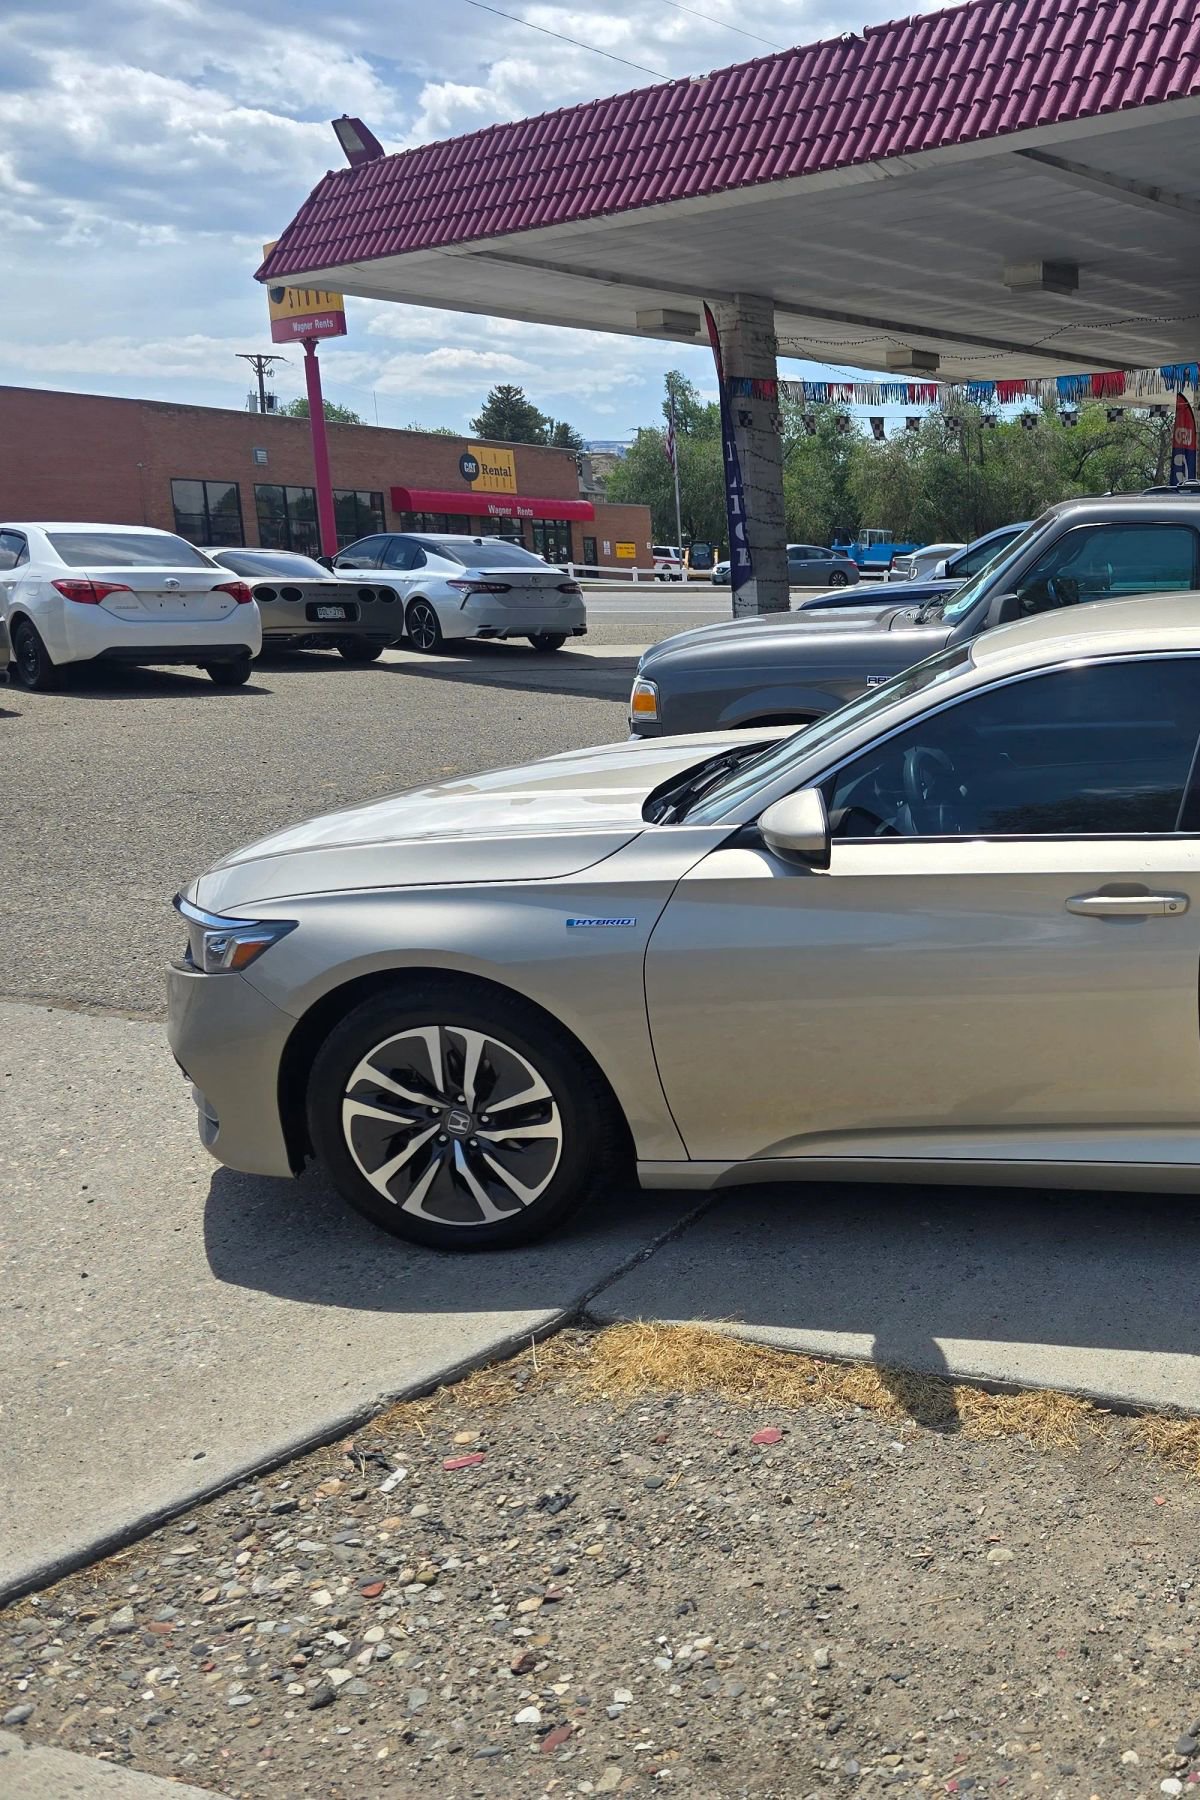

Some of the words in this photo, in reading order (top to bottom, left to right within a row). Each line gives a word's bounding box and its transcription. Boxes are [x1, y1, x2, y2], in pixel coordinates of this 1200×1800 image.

[292, 322, 313, 333] Wagner
[314, 319, 334, 329] Rents
[464, 462, 476, 473] CAT
[481, 464, 512, 477] Rental
[487, 504, 512, 517] Wagner
[516, 506, 534, 517] Rents
